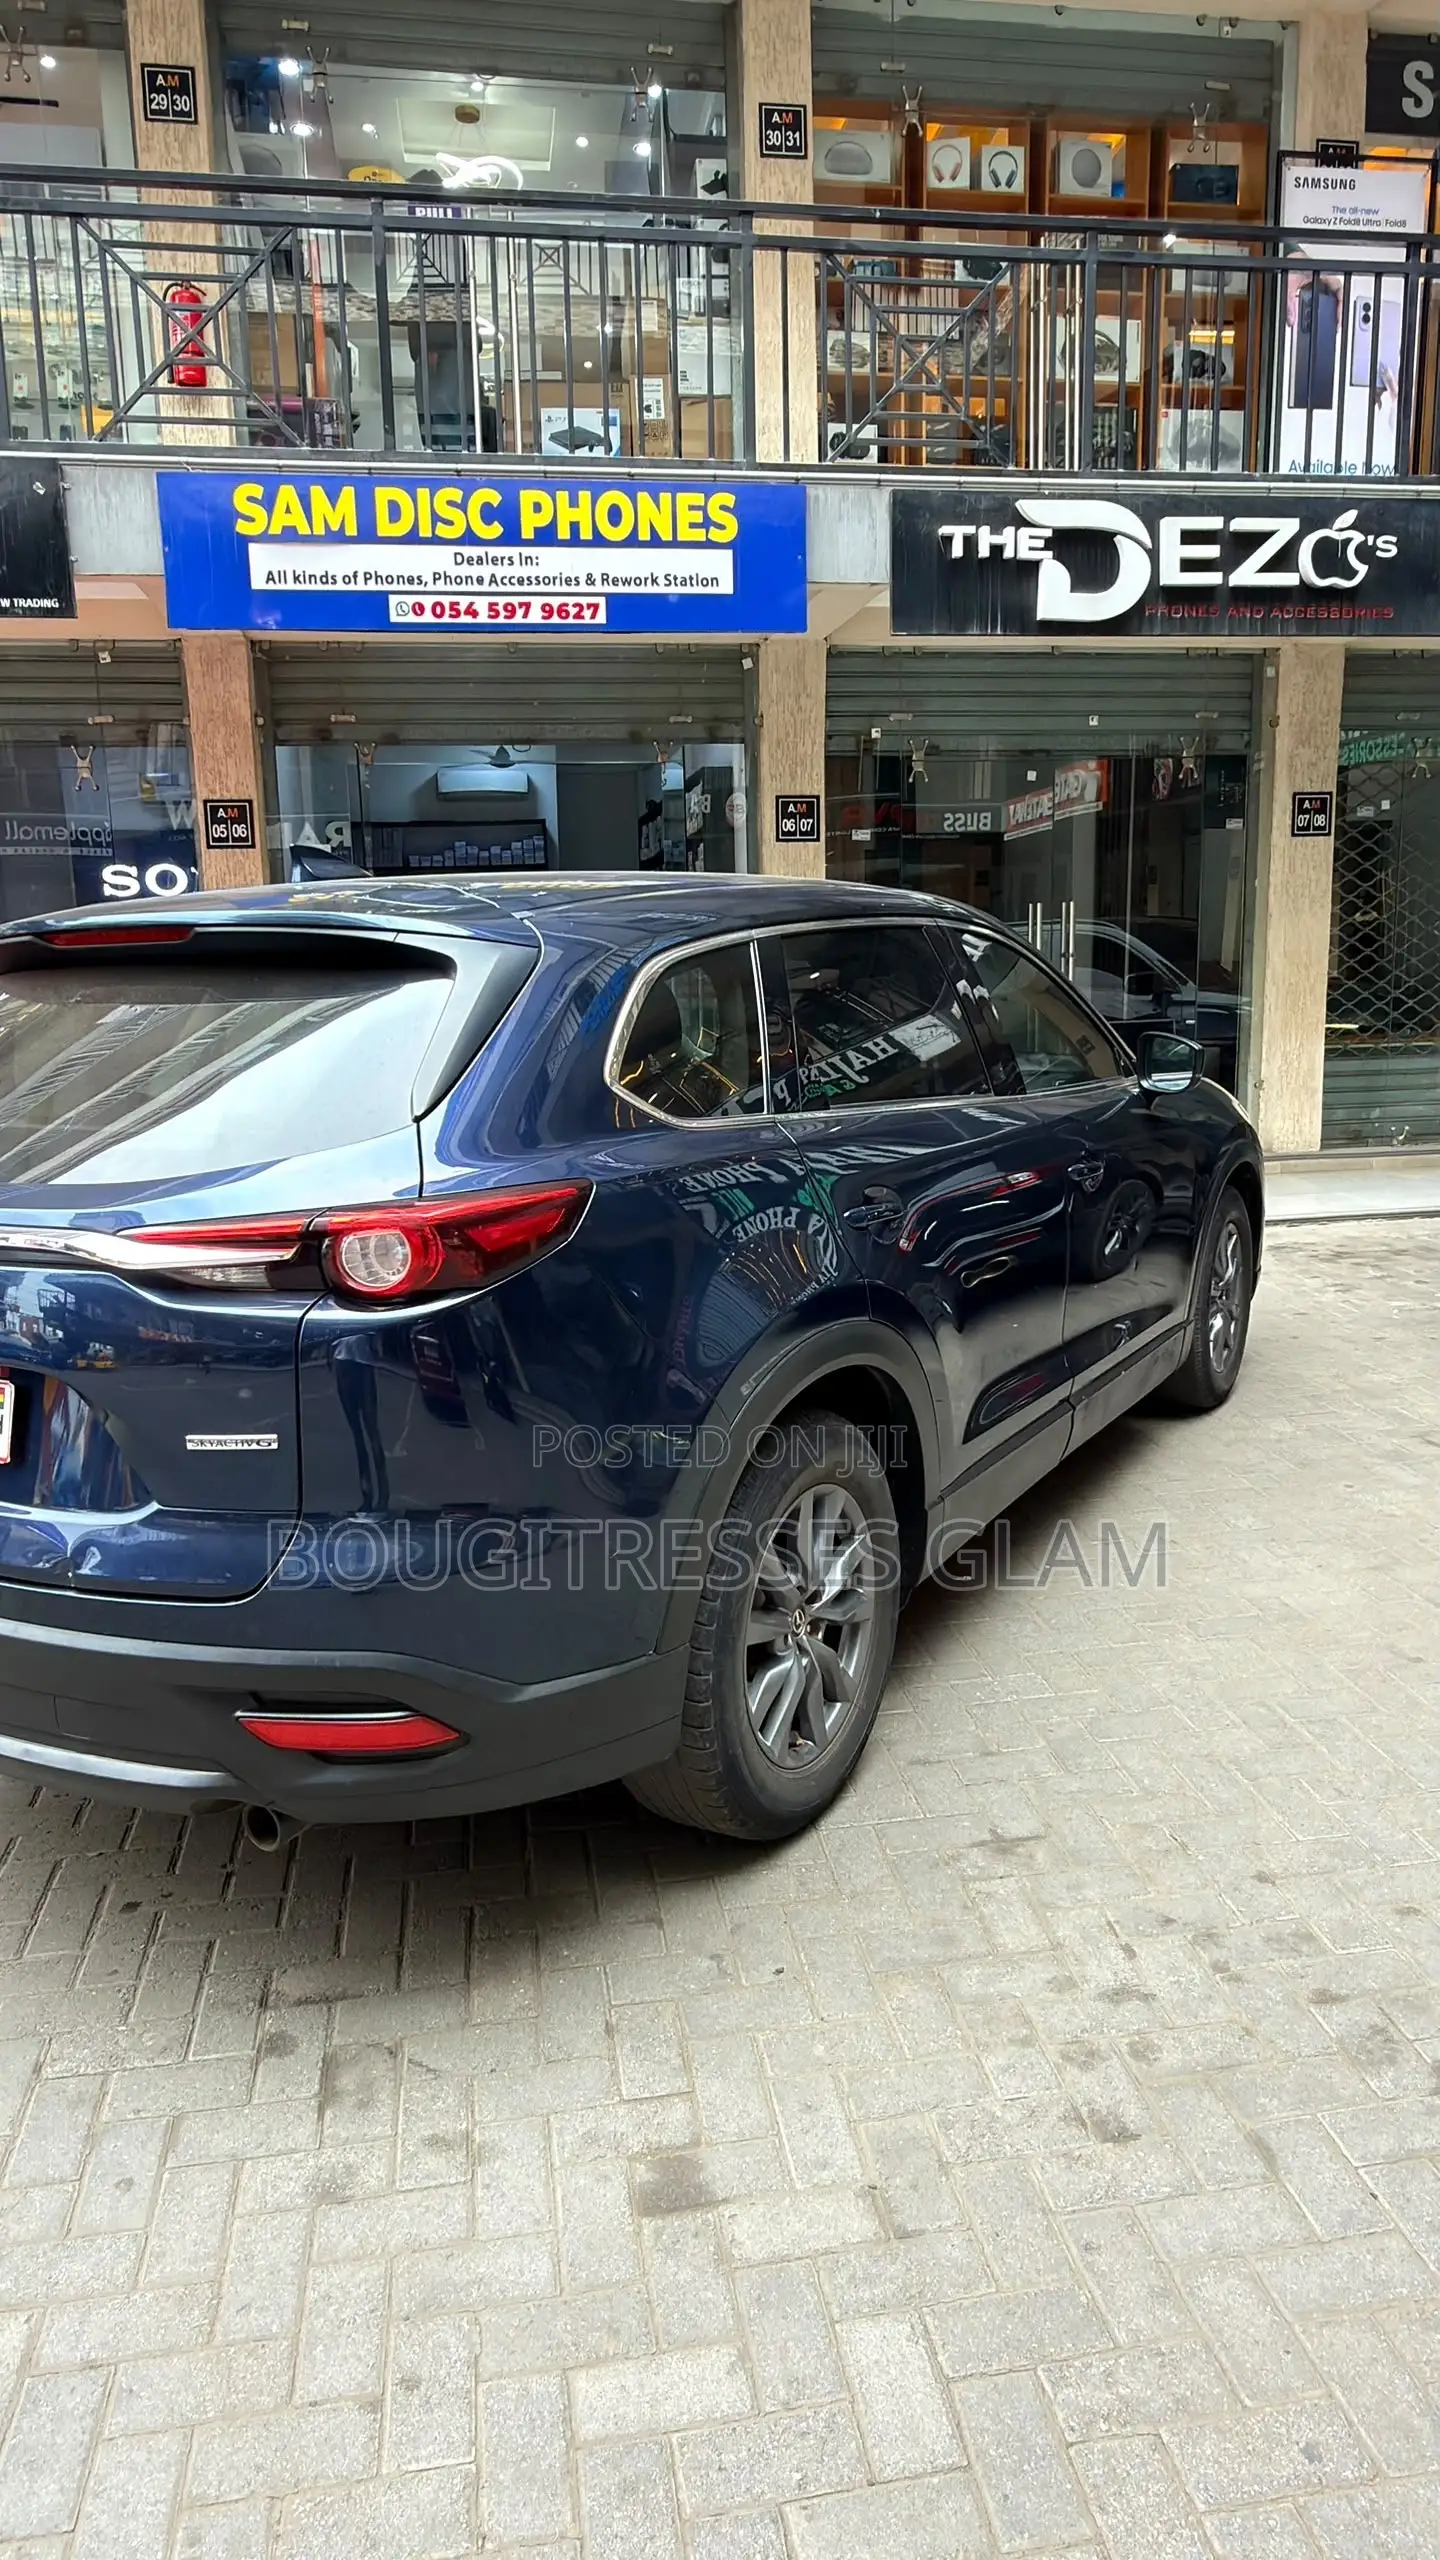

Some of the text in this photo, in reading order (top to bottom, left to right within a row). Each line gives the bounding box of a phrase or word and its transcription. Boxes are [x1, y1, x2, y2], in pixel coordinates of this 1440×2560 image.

[150, 93, 190, 112] 29 30
[766, 130, 800, 147] 30 31
[1294, 176, 1357, 191] SAMSUNG
[1332, 205, 1380, 216] The all-new
[1302, 215, 1333, 227] Galaxy
[1333, 217, 1338, 225] Z
[1362, 218, 1381, 227] Ultra
[1385, 219, 1407, 228] Fold8
[233, 483, 739, 544] SAM DISC PHONES
[938, 525, 1053, 561] THE
[454, 551, 540, 567] Dealers In:
[265, 570, 720, 588] All kinds of Phones, Phone Accessories & Rework Station
[13, 597, 60, 608] TRADING
[431, 601, 600, 620] 054 597 9627
[1144, 604, 1395, 619] PHONES AND ACCESSORIES
[782, 818, 796, 832] 06
[800, 818, 814, 832] 07
[1297, 814, 1326, 827] 07 08
[212, 824, 228, 838] 05
[232, 824, 247, 838] 06
